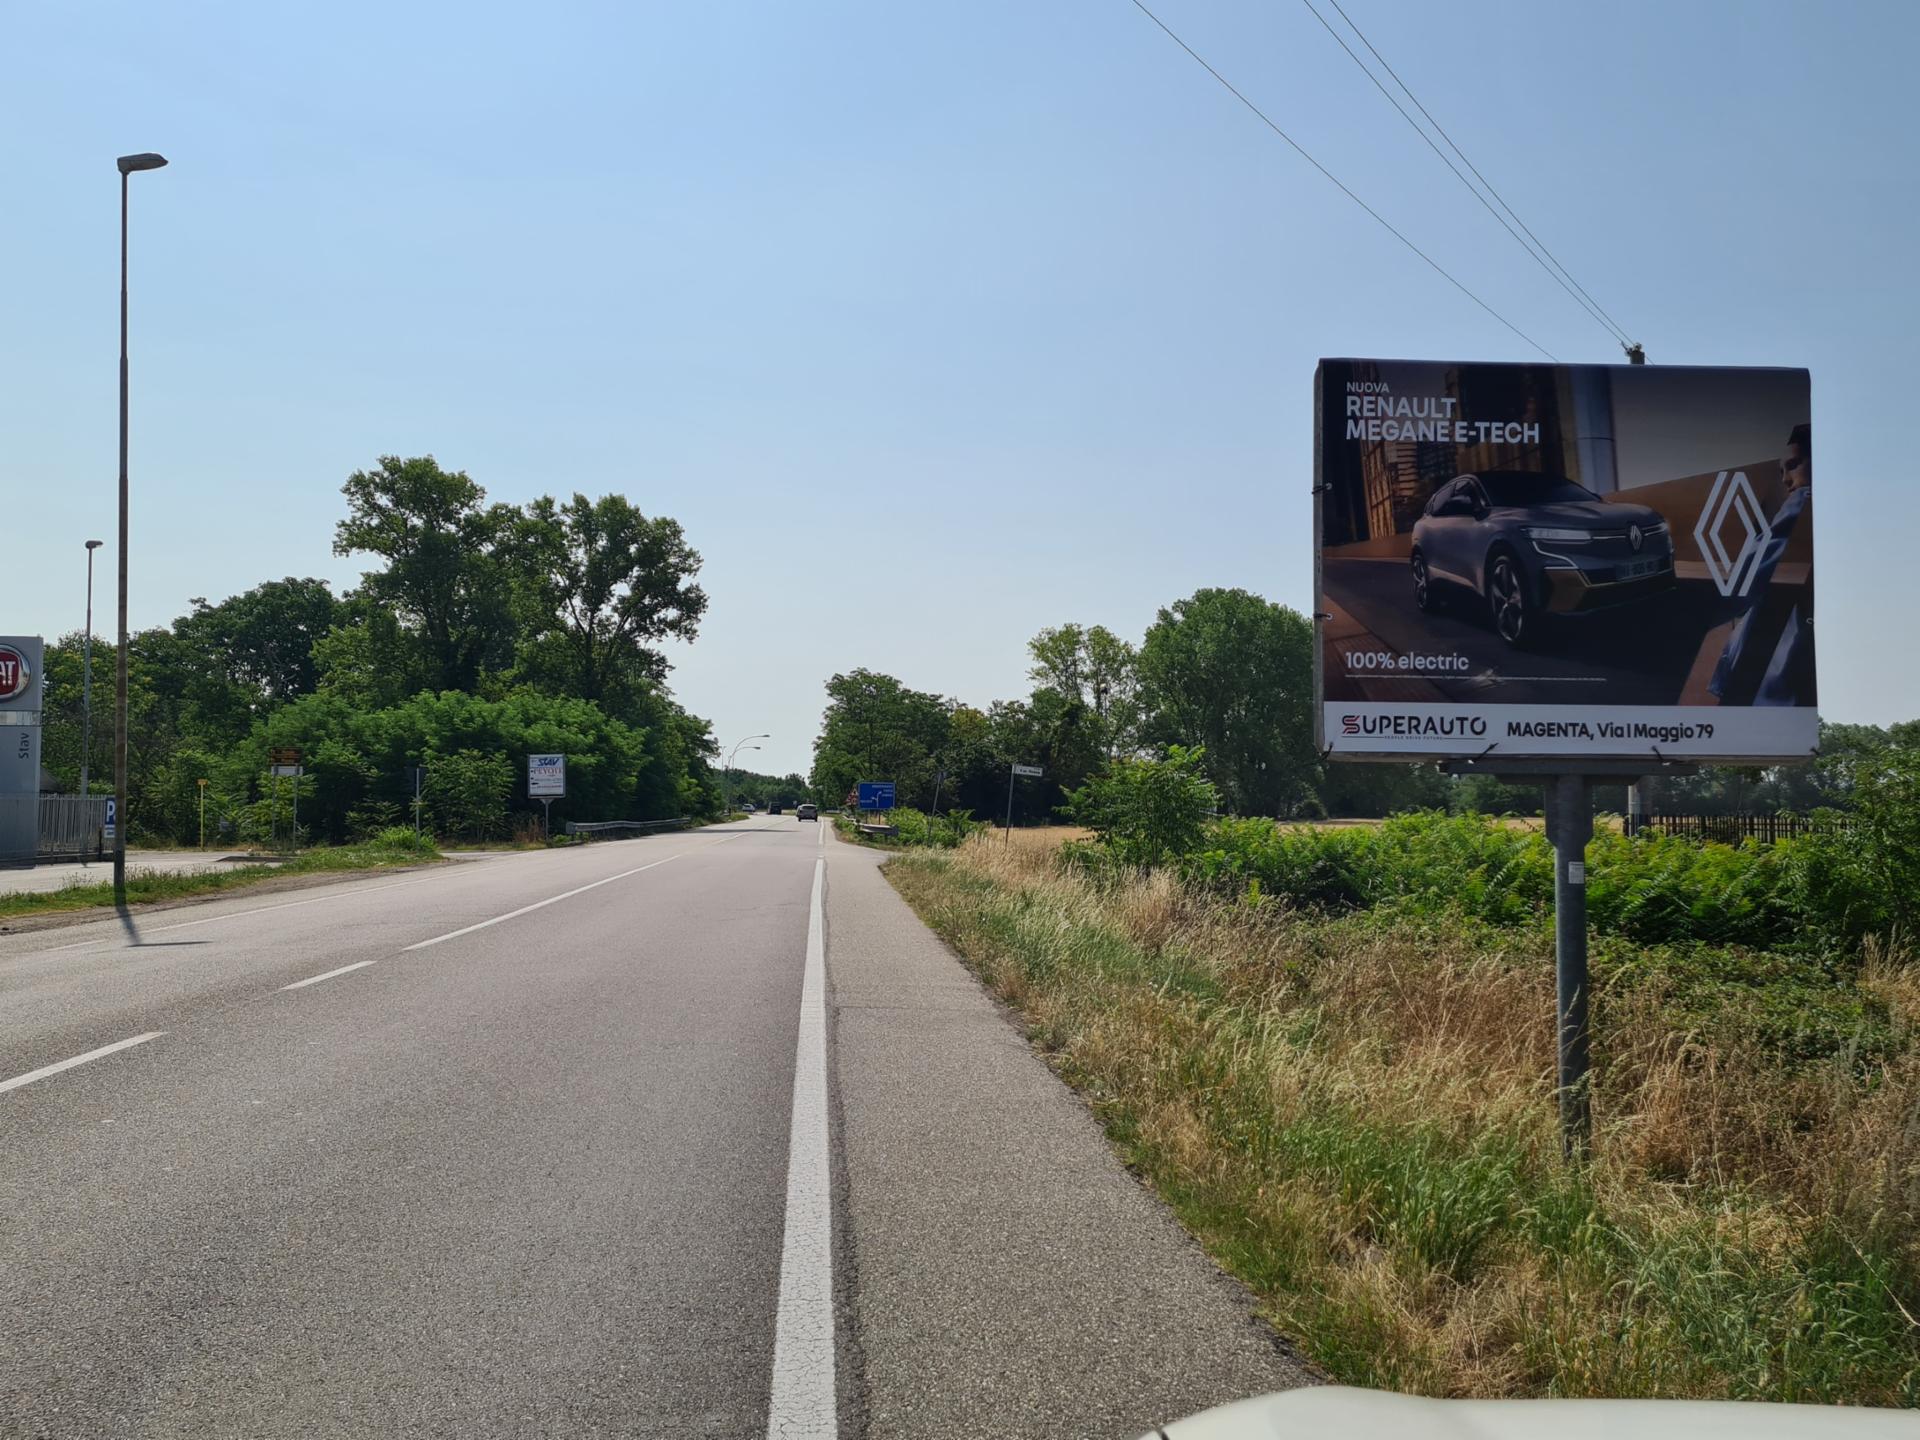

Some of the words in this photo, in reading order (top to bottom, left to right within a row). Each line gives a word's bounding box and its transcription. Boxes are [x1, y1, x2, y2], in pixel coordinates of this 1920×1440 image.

[1346, 382, 1390, 393] NUOVA
[1346, 395, 1457, 418] RENAULT
[1346, 419, 1450, 442] MEGANE
[1454, 421, 1540, 444] E-TECH
[1345, 652, 1396, 670] 100%
[1398, 652, 1470, 670] electric
[1342, 715, 1487, 736] SUPERAUTO
[1507, 722, 1594, 741] MAGENTA,
[1597, 722, 1625, 739] Via
[1633, 723, 1694, 743] Maggio
[1696, 723, 1714, 739] 79
